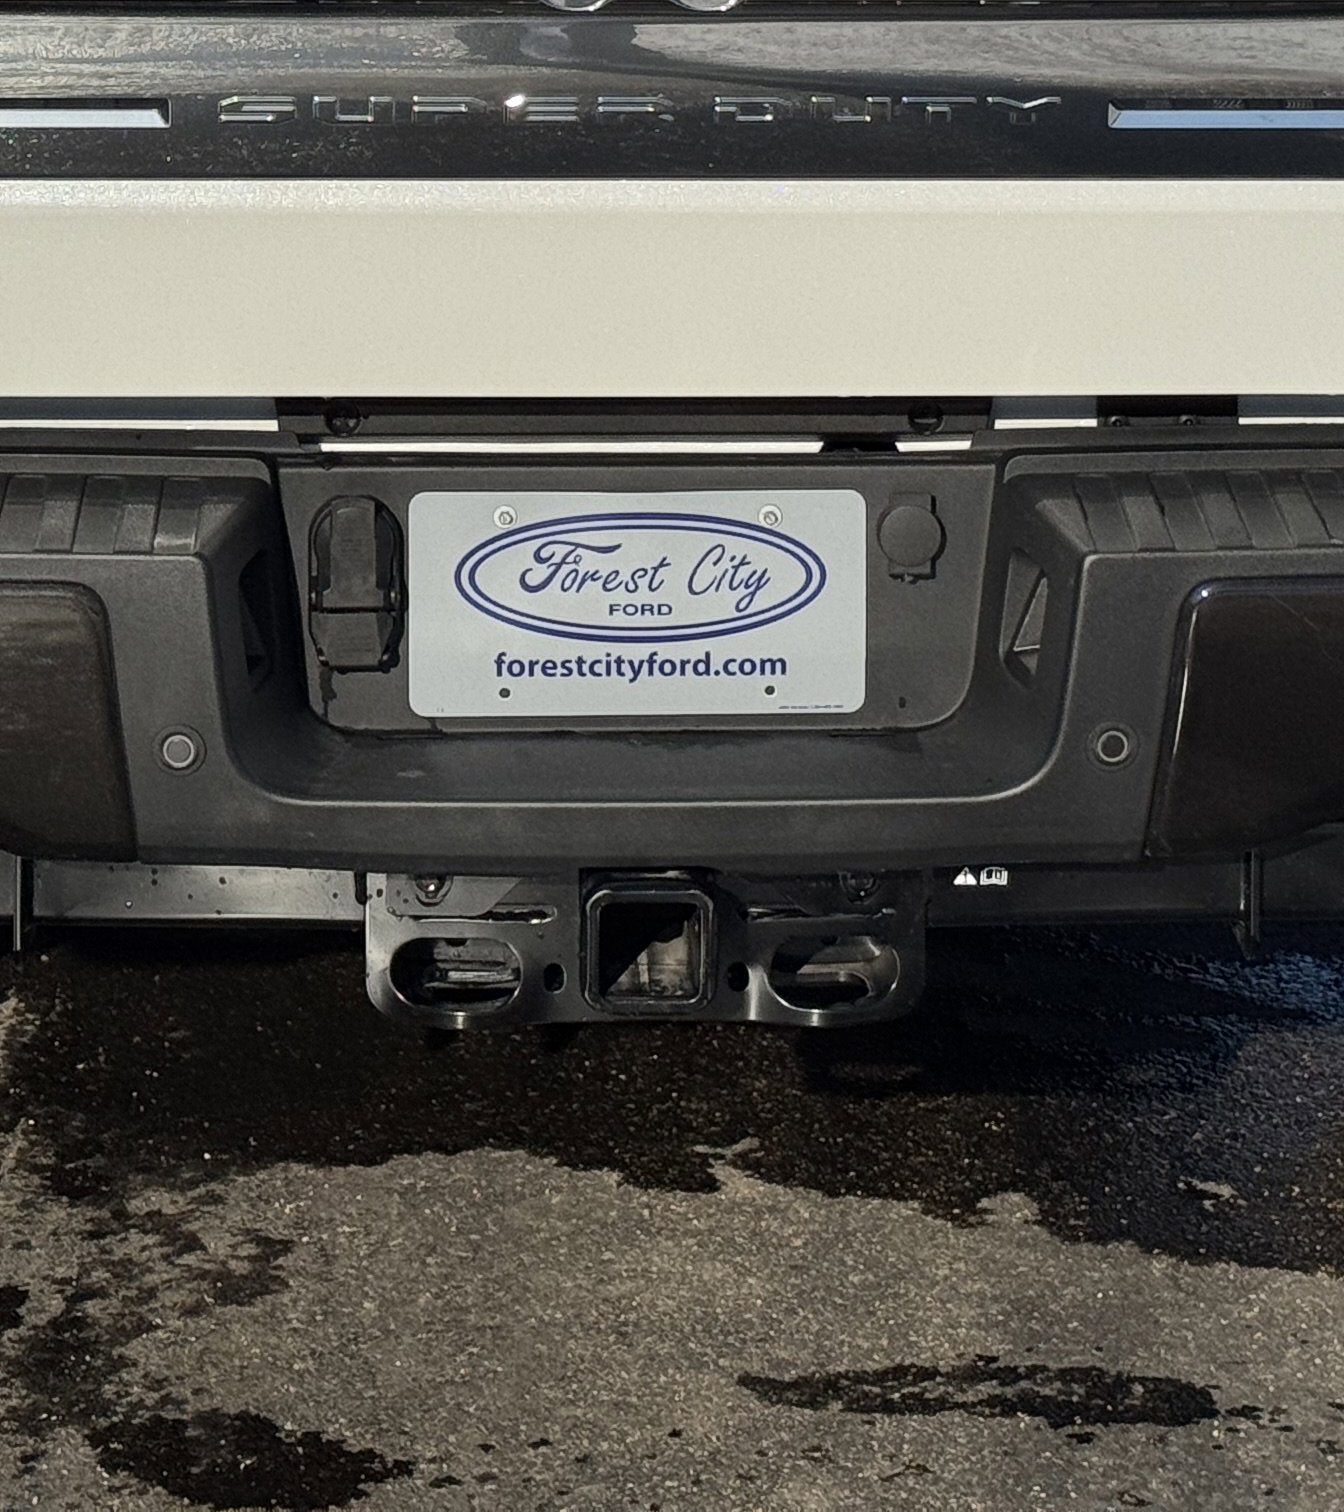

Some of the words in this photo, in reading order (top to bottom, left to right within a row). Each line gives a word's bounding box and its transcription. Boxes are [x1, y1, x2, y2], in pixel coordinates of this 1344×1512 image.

[218, 95, 676, 125] SUPER
[712, 95, 1062, 126] DUTY
[518, 539, 672, 594] Forest
[687, 543, 772, 614] City
[608, 603, 673, 616] FORD
[493, 651, 788, 683] forestcityford.com
